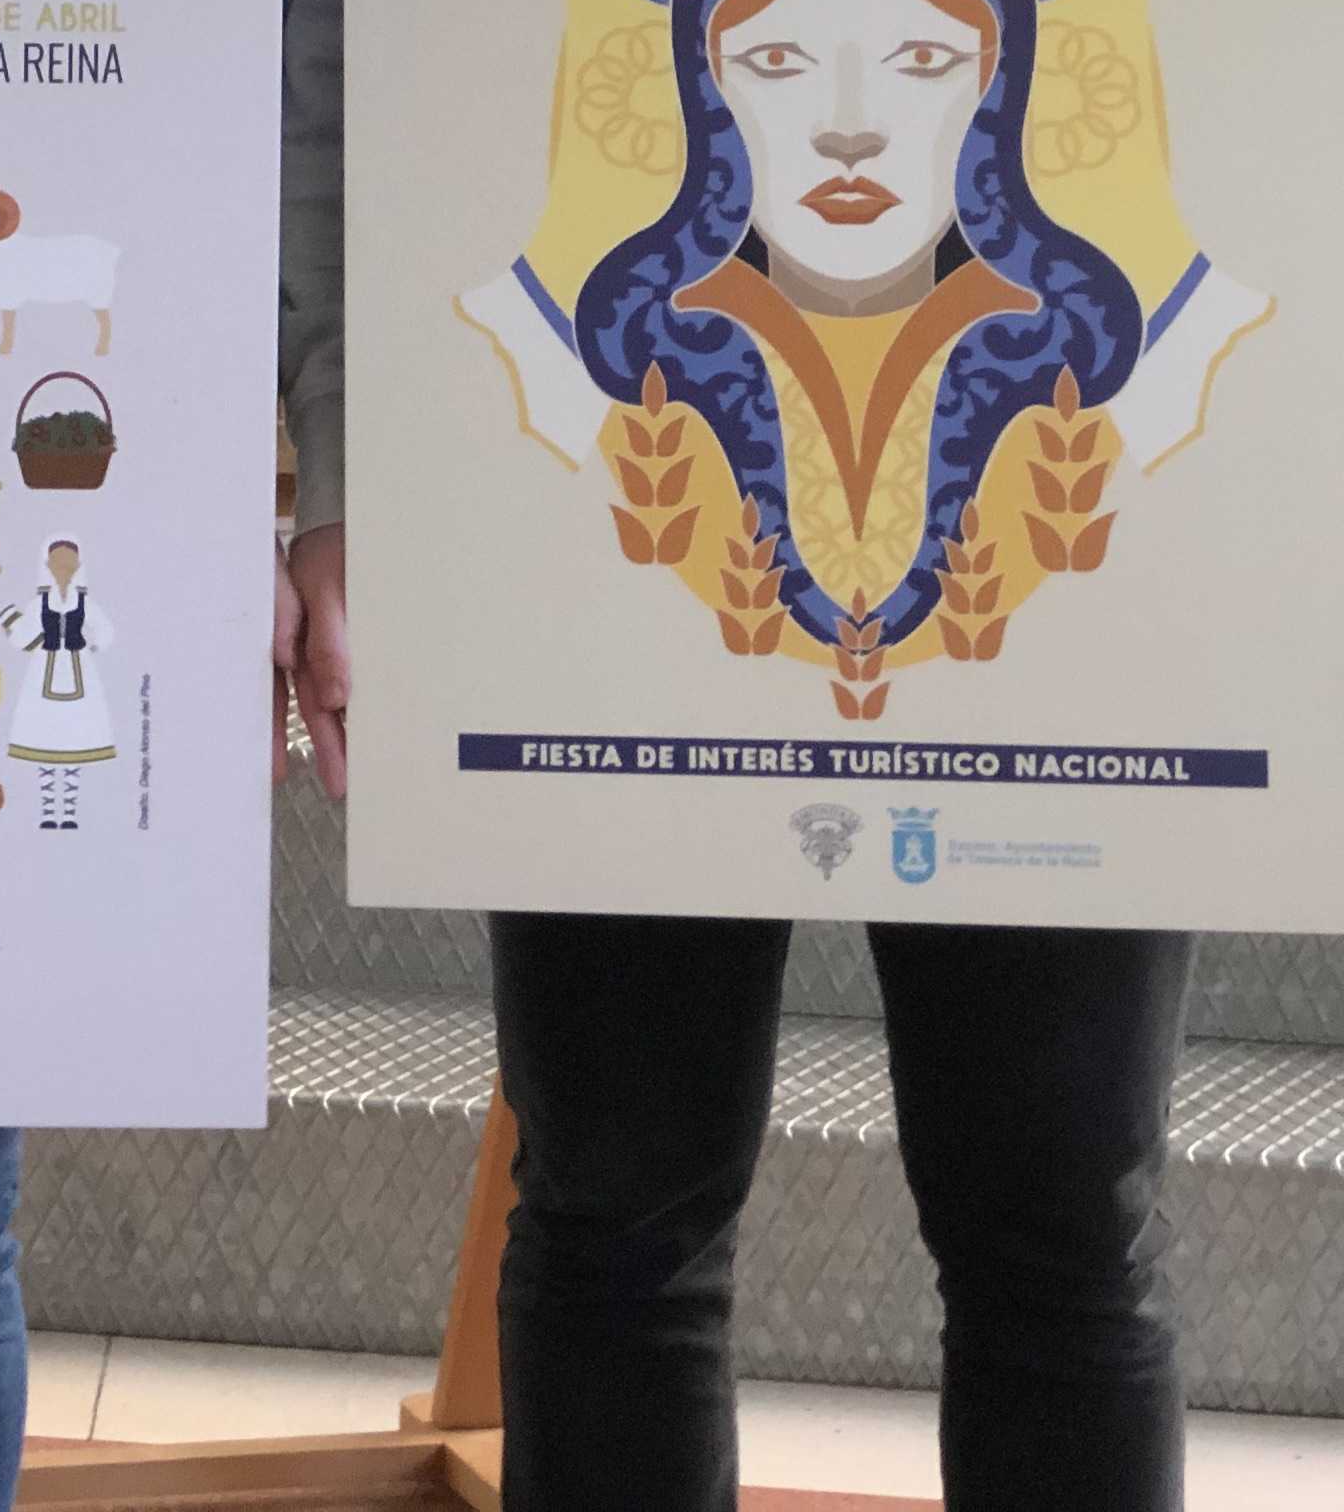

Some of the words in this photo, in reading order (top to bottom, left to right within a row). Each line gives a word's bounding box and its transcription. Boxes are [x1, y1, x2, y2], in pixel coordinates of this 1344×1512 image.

[35, 1, 127, 33] ABRIL
[22, 43, 125, 85] REINA
[521, 743, 623, 768] FIESTA
[637, 745, 675, 768] DE
[689, 742, 814, 772] INTERÉS
[828, 744, 1001, 776] TURÍSTICO
[1014, 753, 1190, 780] NACIONAL
